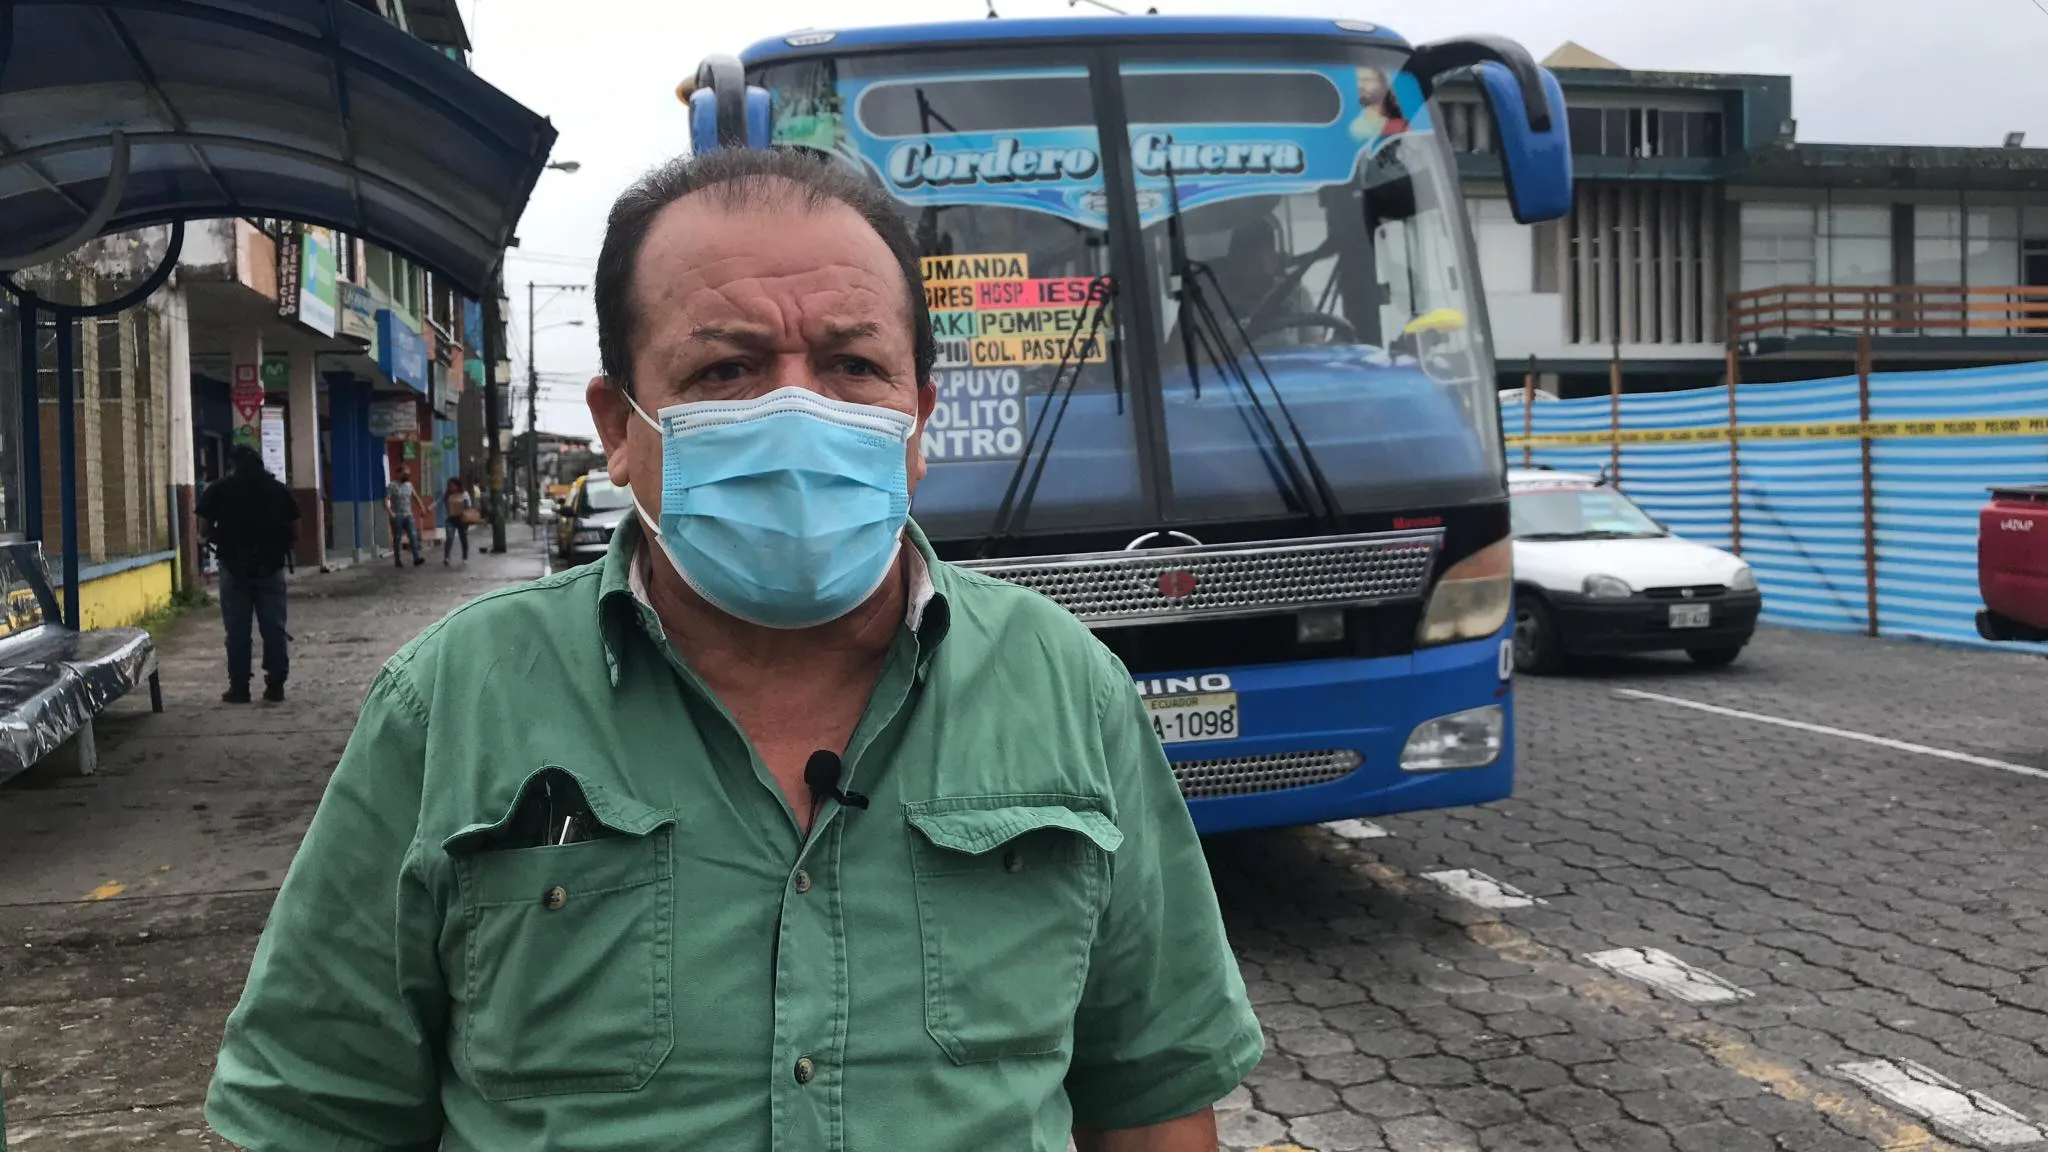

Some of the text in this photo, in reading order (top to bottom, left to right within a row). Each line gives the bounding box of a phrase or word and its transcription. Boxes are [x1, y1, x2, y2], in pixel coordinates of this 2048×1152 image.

[889, 132, 1304, 188] Cordero Guerra
[975, 339, 1016, 363] COL.
[1151, 697, 1199, 710] ECUADOR
